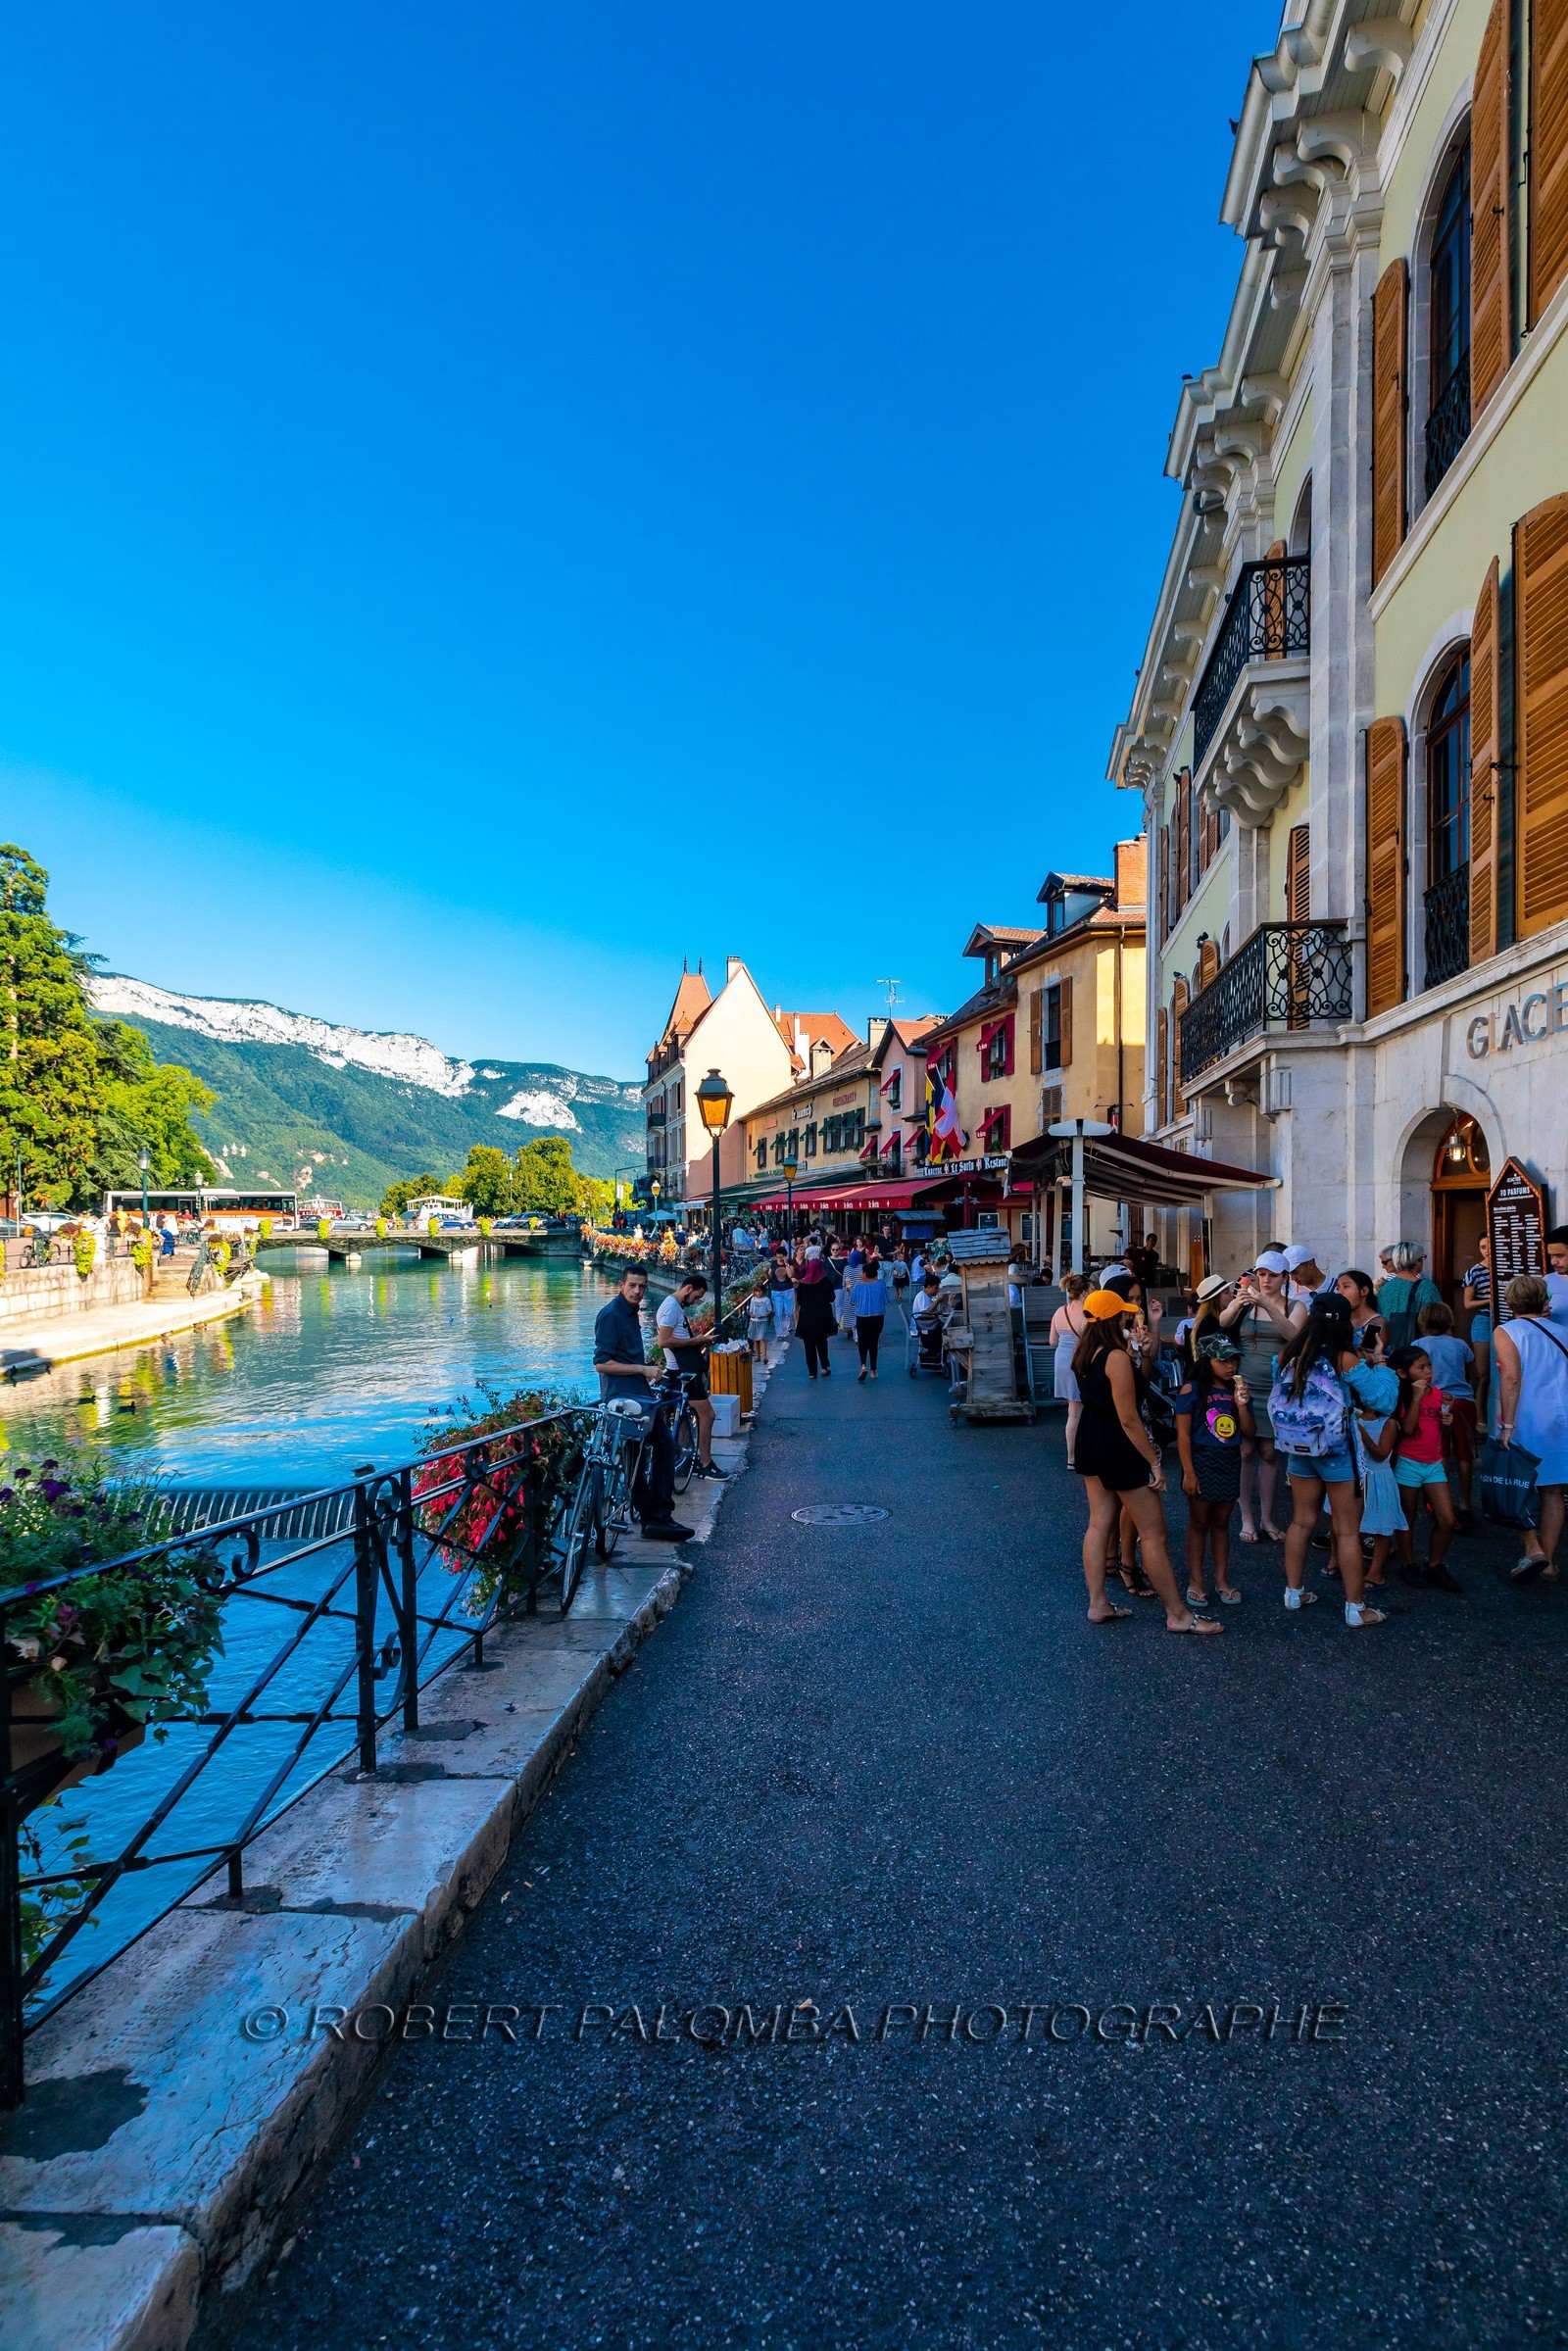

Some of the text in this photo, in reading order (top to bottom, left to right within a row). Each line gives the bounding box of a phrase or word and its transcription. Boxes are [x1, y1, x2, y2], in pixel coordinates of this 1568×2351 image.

[1507, 1186, 1531, 1196] PARFUMS
[1493, 1476, 1503, 1485] DE
[1513, 1479, 1531, 1489] RUE
